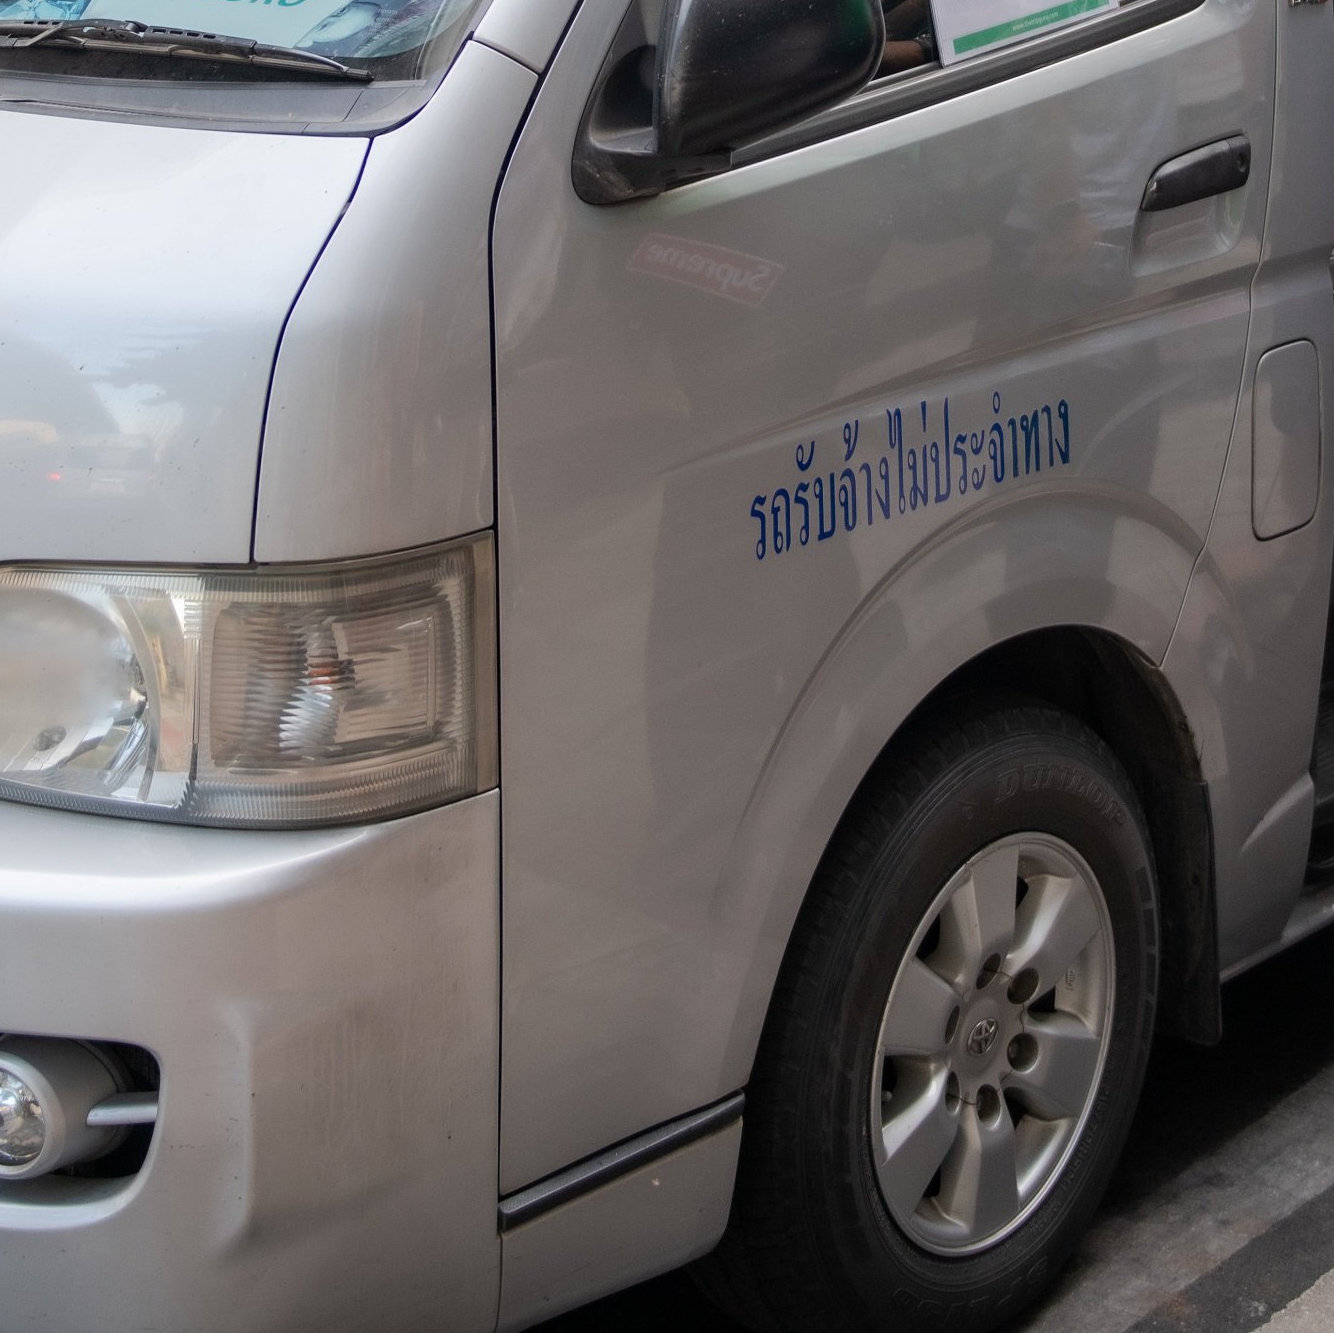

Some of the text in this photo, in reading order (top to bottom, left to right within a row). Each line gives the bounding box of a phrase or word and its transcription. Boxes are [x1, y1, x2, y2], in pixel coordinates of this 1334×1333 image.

[750, 390, 1070, 561] รถรับจ้างไม่ประจำทาง
[994, 762, 1125, 826] DUNLOP
